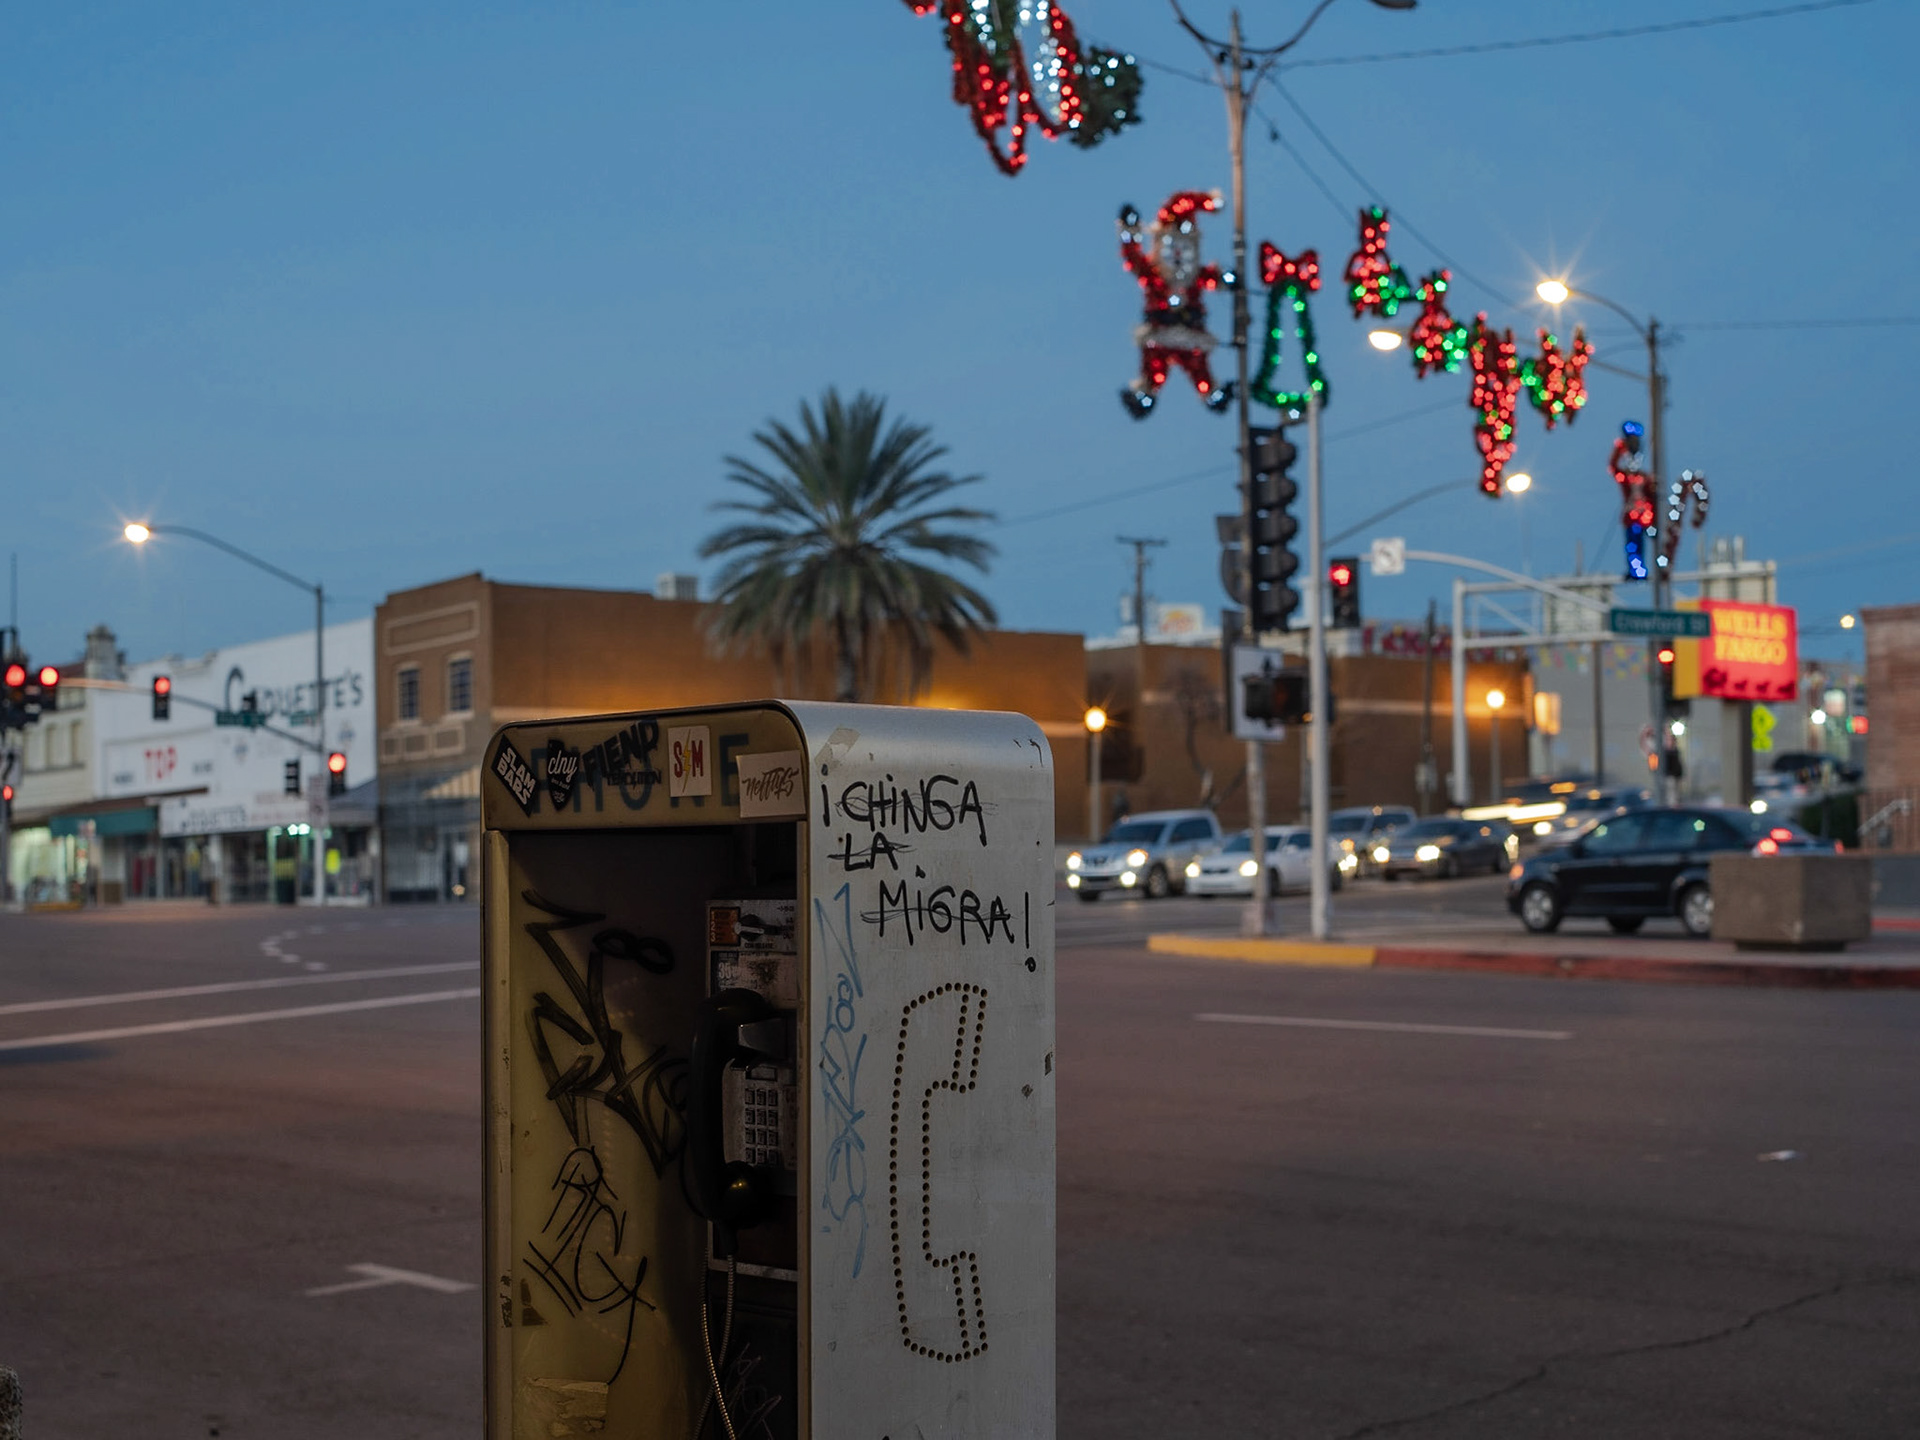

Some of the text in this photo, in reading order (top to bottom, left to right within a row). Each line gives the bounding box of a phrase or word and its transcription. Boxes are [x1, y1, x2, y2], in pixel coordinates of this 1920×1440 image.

[1615, 613, 1707, 635] Crawford St
[1712, 608, 1788, 640] WELLS
[1714, 634, 1788, 666] FARGO
[143, 746, 178, 780] TOP
[502, 747, 536, 793] SLAM
[497, 760, 532, 805] BARS
[844, 831, 899, 872] LA
